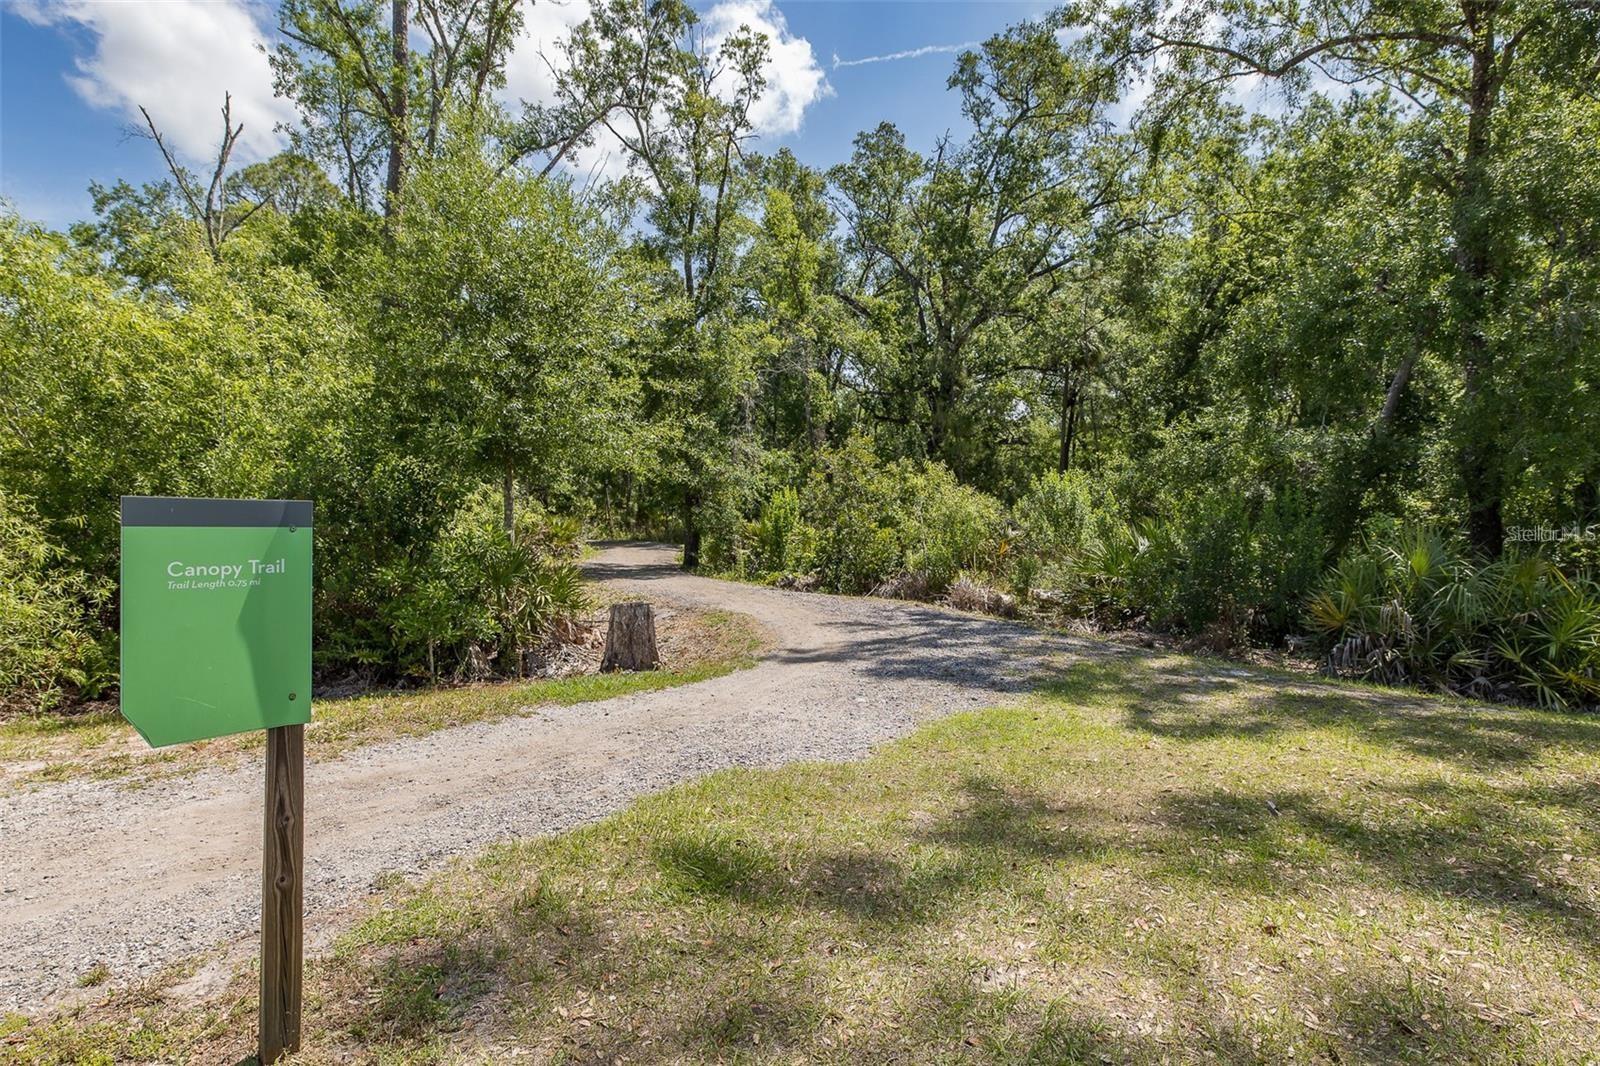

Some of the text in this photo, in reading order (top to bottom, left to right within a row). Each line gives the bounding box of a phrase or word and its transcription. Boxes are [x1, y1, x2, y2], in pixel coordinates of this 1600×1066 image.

[167, 558, 286, 579] Canopy Trail
[167, 577, 261, 590] Trail Length 0.75 mi
